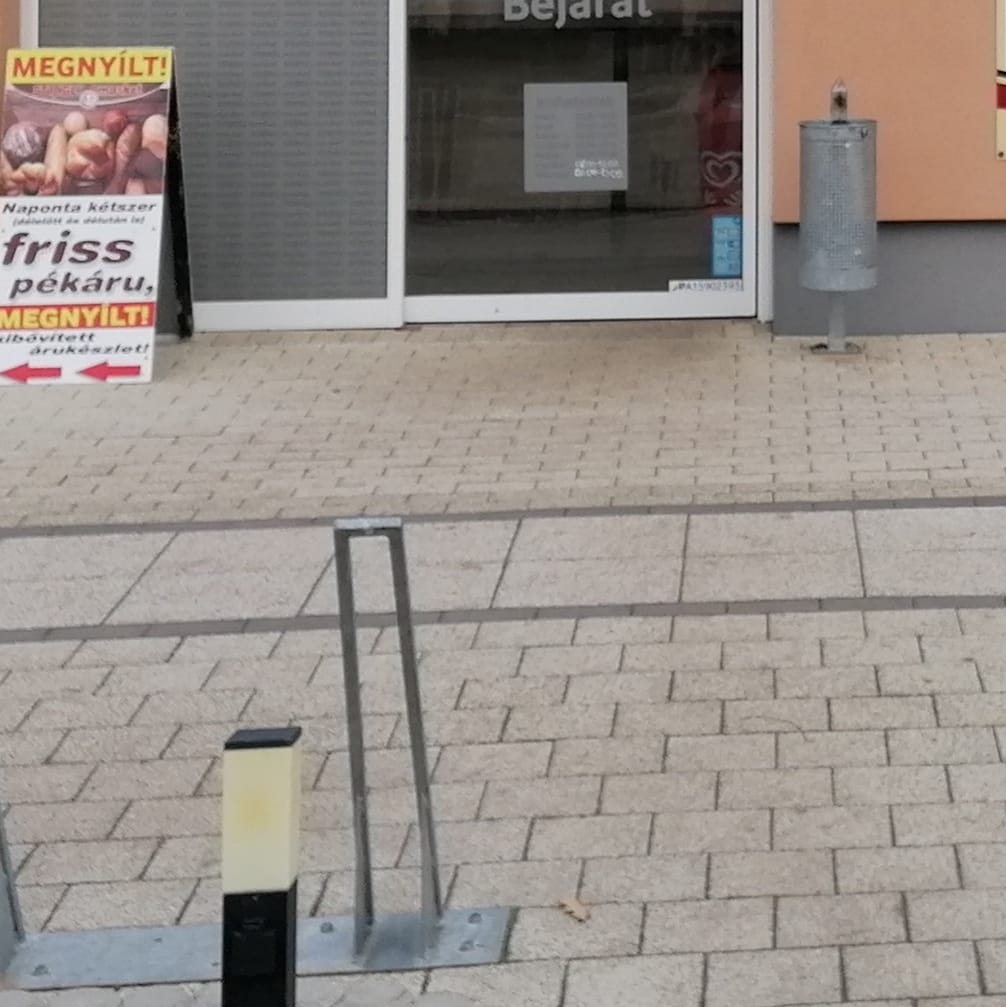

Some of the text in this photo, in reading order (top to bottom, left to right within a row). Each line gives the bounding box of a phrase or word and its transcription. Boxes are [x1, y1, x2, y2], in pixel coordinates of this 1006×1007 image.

[12, 50, 167, 78] MEGNYÍLT!
[2, 201, 157, 216] Naponta kétszer
[2, 229, 135, 266] friss
[8, 269, 154, 300] pékáru,
[0, 303, 150, 329] MEGNYÍLT!
